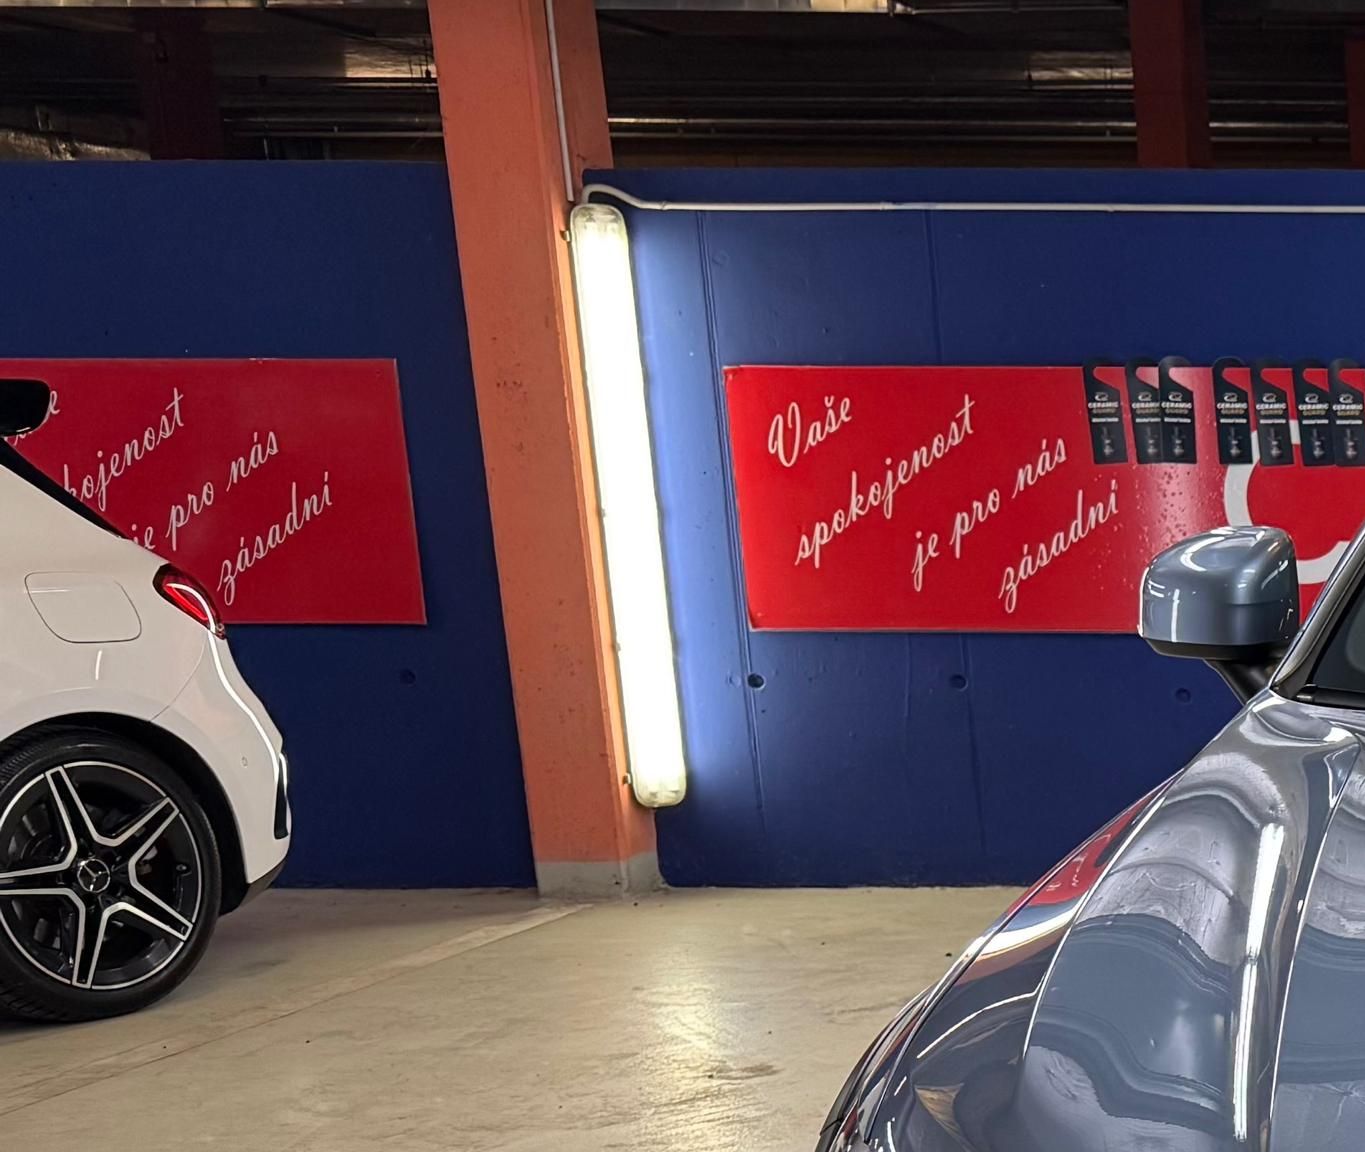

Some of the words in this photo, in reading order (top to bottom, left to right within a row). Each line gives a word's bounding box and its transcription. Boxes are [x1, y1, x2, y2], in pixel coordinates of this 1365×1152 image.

[165, 481, 215, 551] pro
[225, 430, 279, 492] nás
[767, 395, 852, 468] Vaše
[794, 393, 976, 569] spokojenost
[216, 471, 333, 606] zásadní
[910, 530, 940, 592] je
[949, 488, 1001, 559] pro
[1011, 437, 1068, 500] nás
[998, 479, 1120, 614] zásadní
